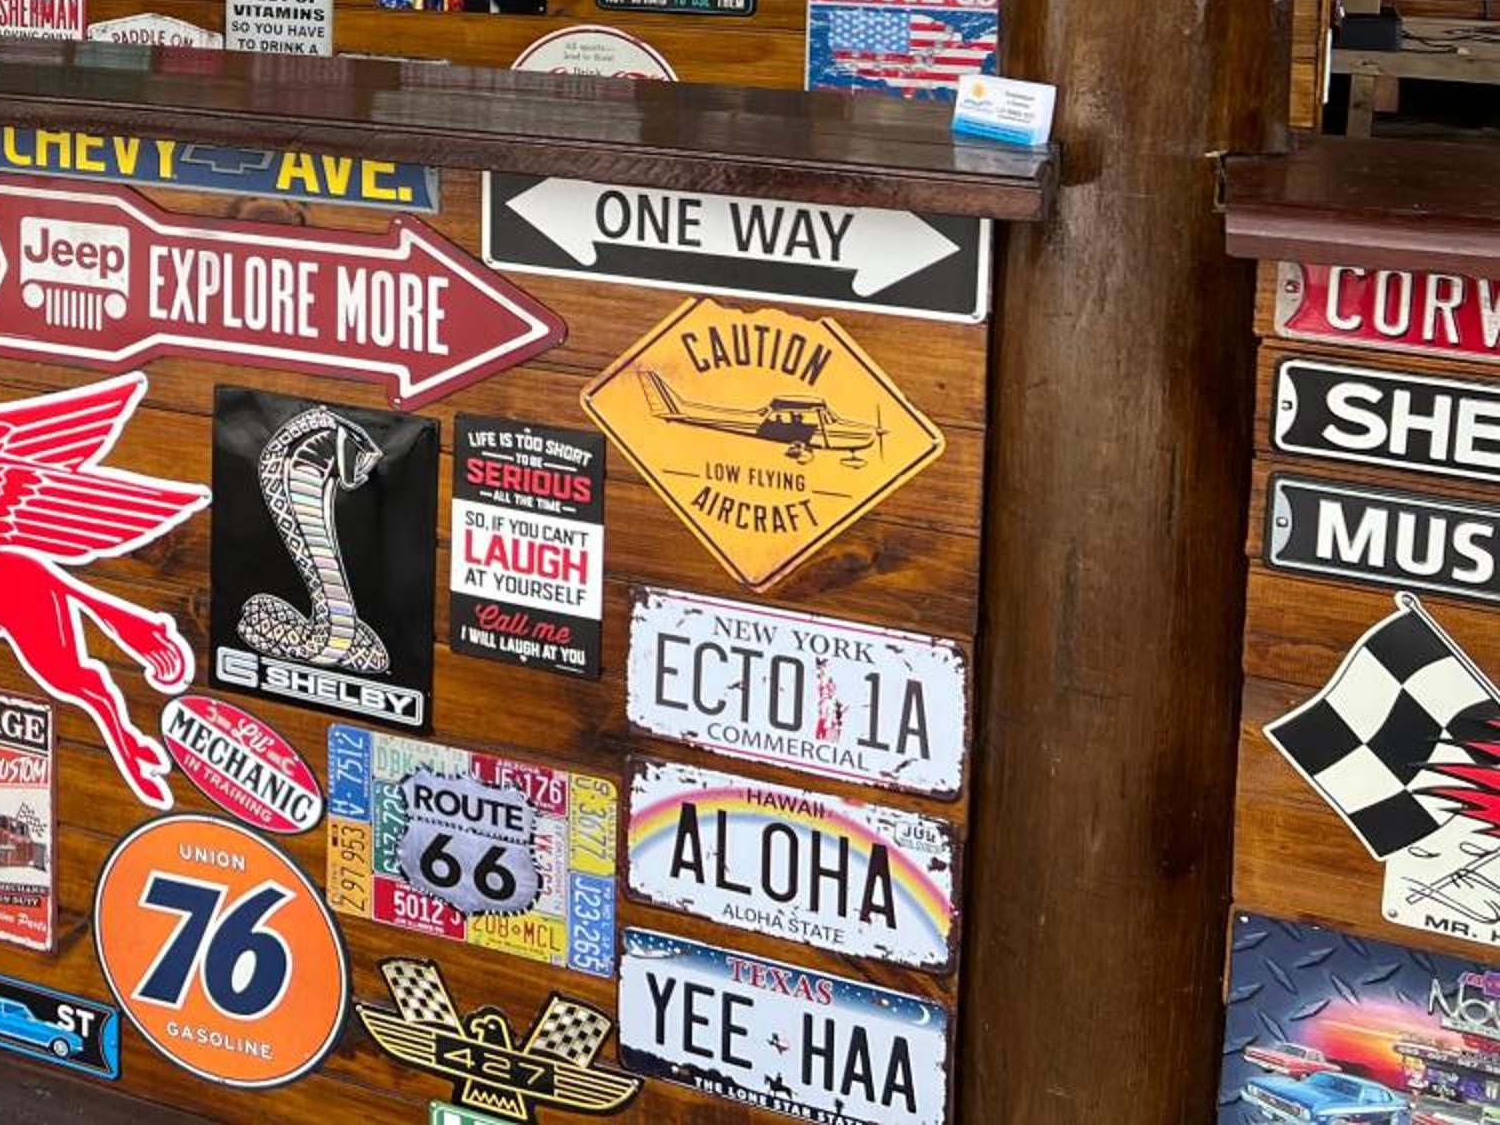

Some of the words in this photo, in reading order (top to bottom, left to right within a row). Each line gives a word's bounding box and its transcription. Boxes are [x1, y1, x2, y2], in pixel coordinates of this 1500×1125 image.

[596, 190, 701, 246] ONE
[731, 203, 853, 261] WAY
[25, 226, 125, 278] Jeep
[149, 245, 317, 337] EXPLORE
[338, 269, 449, 354] MORE
[682, 325, 831, 386] CAUTION
[467, 458, 591, 502] SERIOUS
[705, 462, 741, 480] LOW
[749, 467, 805, 492] FLYING
[690, 486, 818, 533] AIRCRAFT
[464, 528, 587, 584] LAUGH
[465, 568, 486, 587] AT
[493, 574, 586, 606] YOURSELF
[713, 616, 779, 645] NEW
[792, 631, 873, 663] YORK
[267, 670, 412, 718] SHELBY
[655, 632, 803, 731] ECTO
[857, 672, 931, 760] 1A
[707, 722, 869, 771] COMMERCIAL
[746, 787, 825, 819] HAWAII
[180, 844, 246, 871] UNION
[671, 803, 896, 929] ALOHA
[133, 872, 294, 1021] 76
[723, 904, 784, 931] ALOHA
[787, 917, 845, 945] STATE
[727, 956, 834, 1005] TEXAS
[57, 1005, 94, 1039] ST
[167, 1022, 273, 1061] GASOLINE
[646, 972, 753, 1069] YEE
[803, 1013, 916, 1114] HAA
